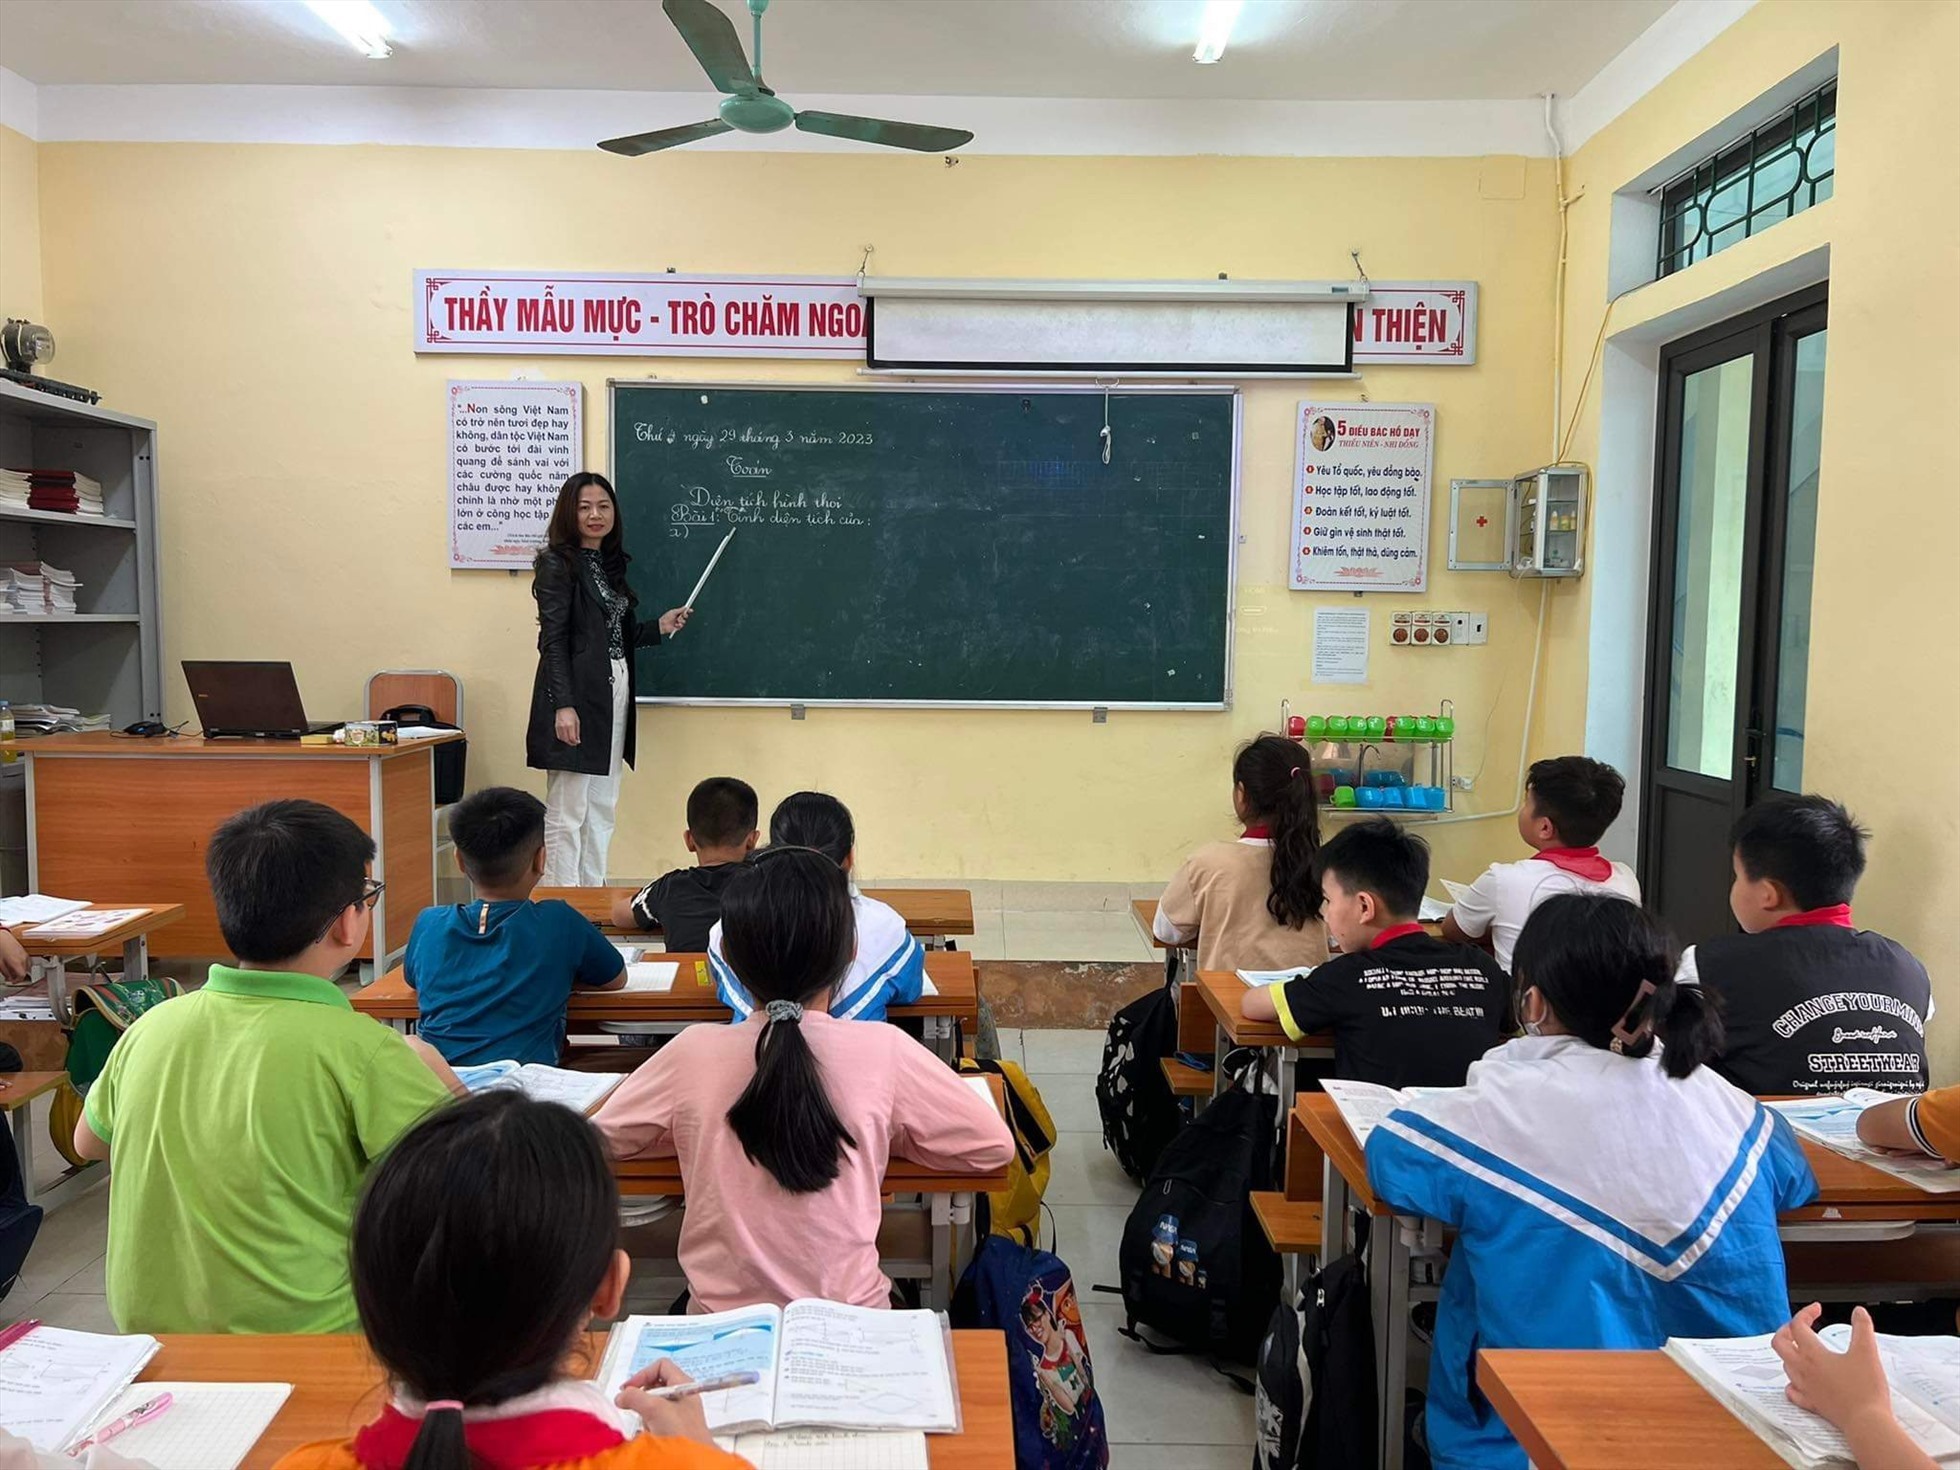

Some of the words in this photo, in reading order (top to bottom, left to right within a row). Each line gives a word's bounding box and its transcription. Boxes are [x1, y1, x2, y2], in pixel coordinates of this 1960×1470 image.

[444, 286, 508, 332] THẦY
[517, 285, 575, 333] MẪU
[584, 296, 641, 341] MỰC
[668, 293, 715, 335] TRÒ
[725, 294, 799, 336] CHĂM
[1372, 302, 1447, 350] THIỆN
[493, 404, 518, 416] sông
[523, 405, 542, 416] Việt
[547, 406, 569, 415] Nam
[456, 419, 468, 427] có
[487, 418, 505, 427] nên
[507, 419, 528, 427] tươi
[531, 419, 549, 429] đẹp
[551, 419, 569, 430] hay
[1337, 420, 1347, 436] 5
[1403, 427, 1421, 439] DẠY
[456, 431, 488, 441] không,
[490, 431, 508, 440] dân
[510, 432, 526, 442] tộc
[527, 432, 545, 442] Việt
[547, 433, 569, 441] Nam
[634, 422, 664, 441] Thứ
[683, 430, 714, 449] ngày
[720, 428, 736, 442] 29
[740, 427, 780, 450] tháng
[799, 430, 833, 444] năm
[839, 431, 873, 445] 2023
[456, 444, 468, 453] có
[474, 443, 501, 453] bước
[507, 444, 520, 453] tới
[527, 445, 542, 453] đài
[548, 445, 569, 454] vinh
[456, 459, 486, 468] quang
[490, 456, 503, 466] để
[507, 457, 531, 466] sánh
[535, 458, 549, 467] vai
[553, 457, 569, 467] với
[726, 455, 772, 475] Toán
[456, 470, 474, 479] các
[480, 470, 512, 481] cường
[518, 469, 543, 481] quốc
[549, 471, 569, 480] năm
[1316, 465, 1331, 476] Yêu
[1333, 463, 1342, 476] Tổ
[1343, 464, 1365, 478] quốc,
[1367, 466, 1382, 478] yêu
[1383, 464, 1403, 479] đồng
[456, 483, 480, 492] châu
[485, 483, 511, 493] được
[515, 484, 532, 494] hay
[537, 484, 560, 493] khôn
[1315, 486, 1331, 498] Học
[1333, 485, 1347, 498] tập
[1349, 485, 1363, 497] tốt,
[1365, 487, 1378, 496] lao
[1380, 487, 1401, 499] động
[1403, 486, 1417, 497] tốt.
[456, 496, 483, 505] chính
[487, 496, 496, 505] là
[500, 496, 519, 505] nhờ
[523, 497, 542, 508] một
[740, 491, 768, 507] tích
[773, 490, 807, 508] hình
[815, 492, 842, 509] thoi
[457, 509, 473, 518] lớn
[486, 509, 511, 520] công
[513, 510, 531, 520] học
[534, 510, 550, 521] tập
[671, 504, 707, 522] Bài
[770, 510, 801, 527] diện
[807, 510, 835, 526] tích
[1316, 506, 1337, 516] Đoàn
[1339, 506, 1352, 516] kết
[1354, 506, 1367, 518] tốt,
[1380, 507, 1397, 520] luật
[1398, 506, 1412, 518] tốt.
[457, 522, 474, 531] các
[1329, 527, 1343, 539] gìn
[1344, 527, 1354, 539] vệ
[1356, 527, 1373, 538] sinh
[1374, 528, 1391, 541] thật
[1392, 527, 1406, 538] tốt.
[1313, 546, 1334, 557] Khiêm
[1350, 547, 1364, 559] thật
[1381, 547, 1399, 560] dũng
[1807, 1053, 1920, 1073] STREETWEAR
